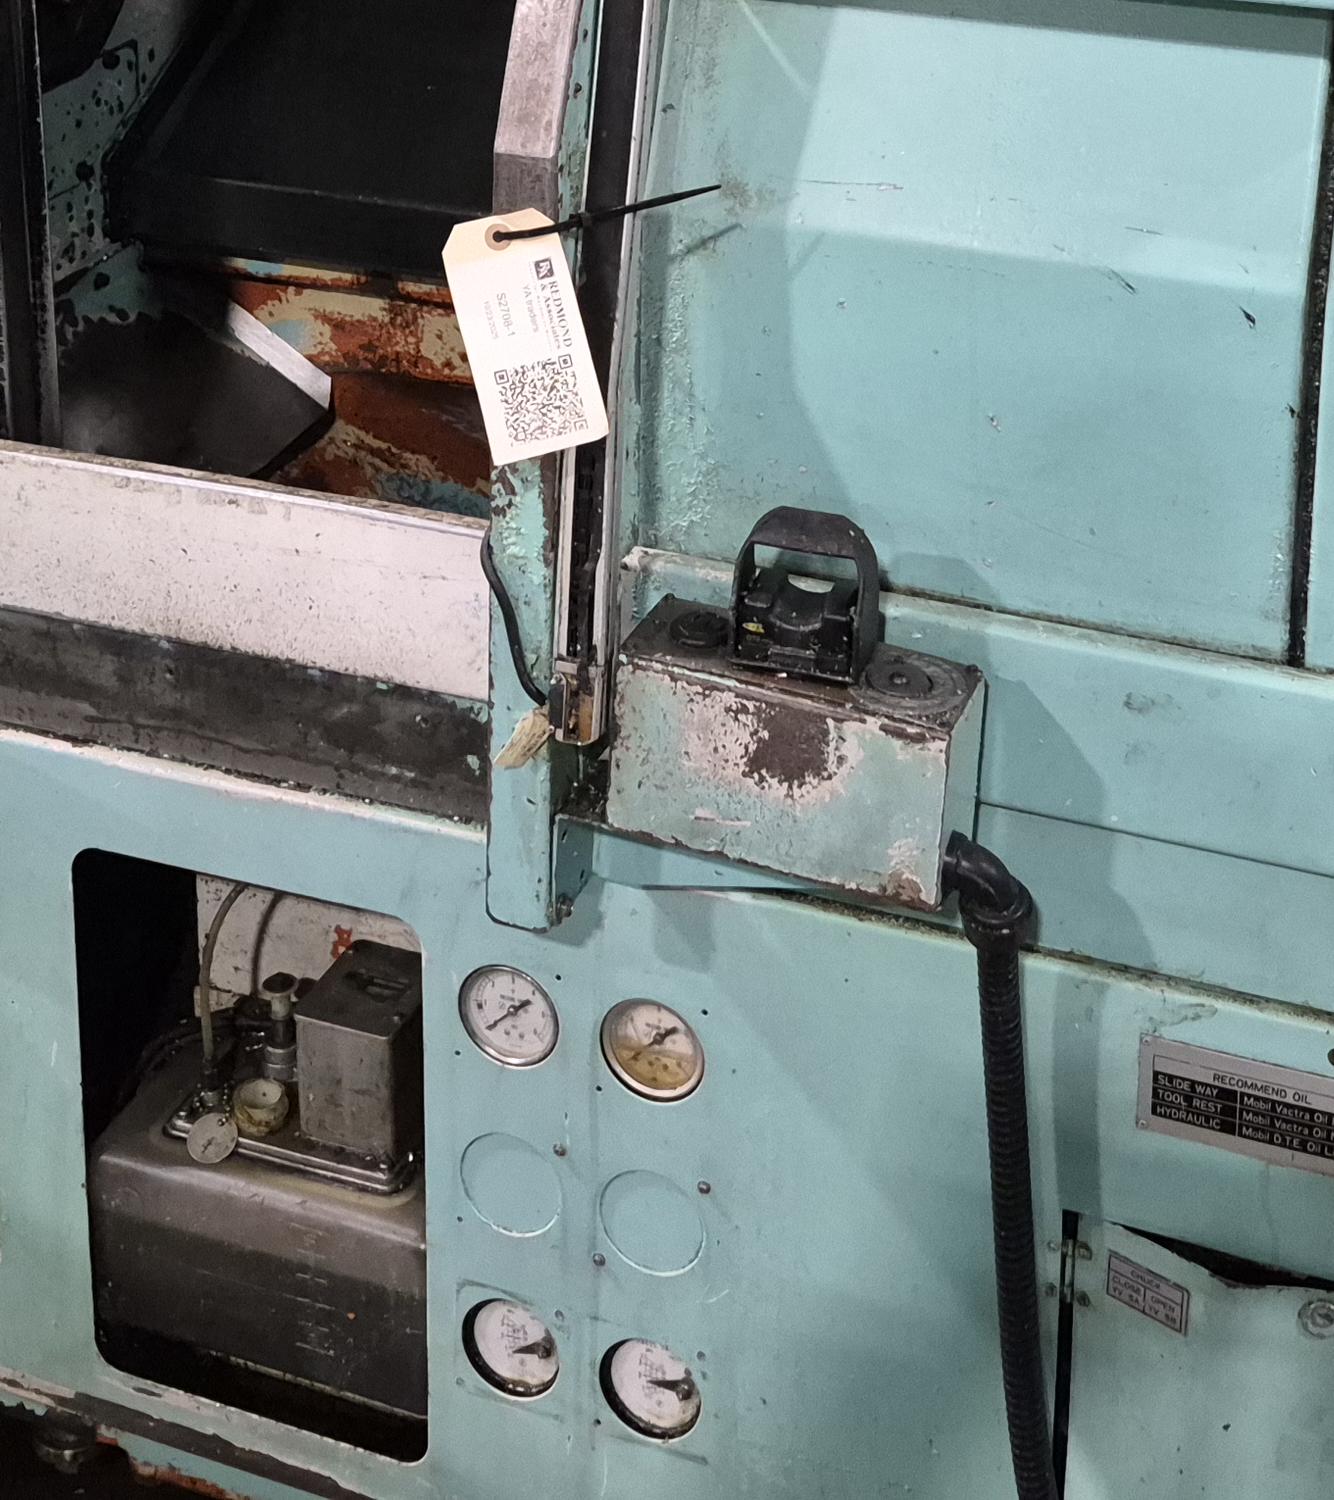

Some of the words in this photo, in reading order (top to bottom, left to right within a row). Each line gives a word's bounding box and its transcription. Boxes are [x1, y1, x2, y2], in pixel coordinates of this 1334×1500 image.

[548, 280, 574, 348] REDMOND
[1156, 1074, 1193, 1092] SLIDE
[1194, 1082, 1219, 1099] WAY
[1243, 1095, 1272, 1112] Mobil
[1275, 1102, 1311, 1121] Vactra
[1313, 1112, 1329, 1126] Oil
[1157, 1088, 1189, 1106] TOOL
[1192, 1097, 1223, 1114] REST
[1242, 1110, 1271, 1127] Mobil
[1274, 1117, 1310, 1137] Vactra
[1312, 1127, 1327, 1140] Oil
[1212, 1072, 1288, 1100] RECOMMEND
[1292, 1091, 1313, 1106] OIL
[1156, 1103, 1221, 1131] HYDRAULIC
[1241, 1124, 1270, 1142] Mobil
[1306, 1141, 1322, 1154] Oil
[1112, 1275, 1142, 1295] CLOSE
